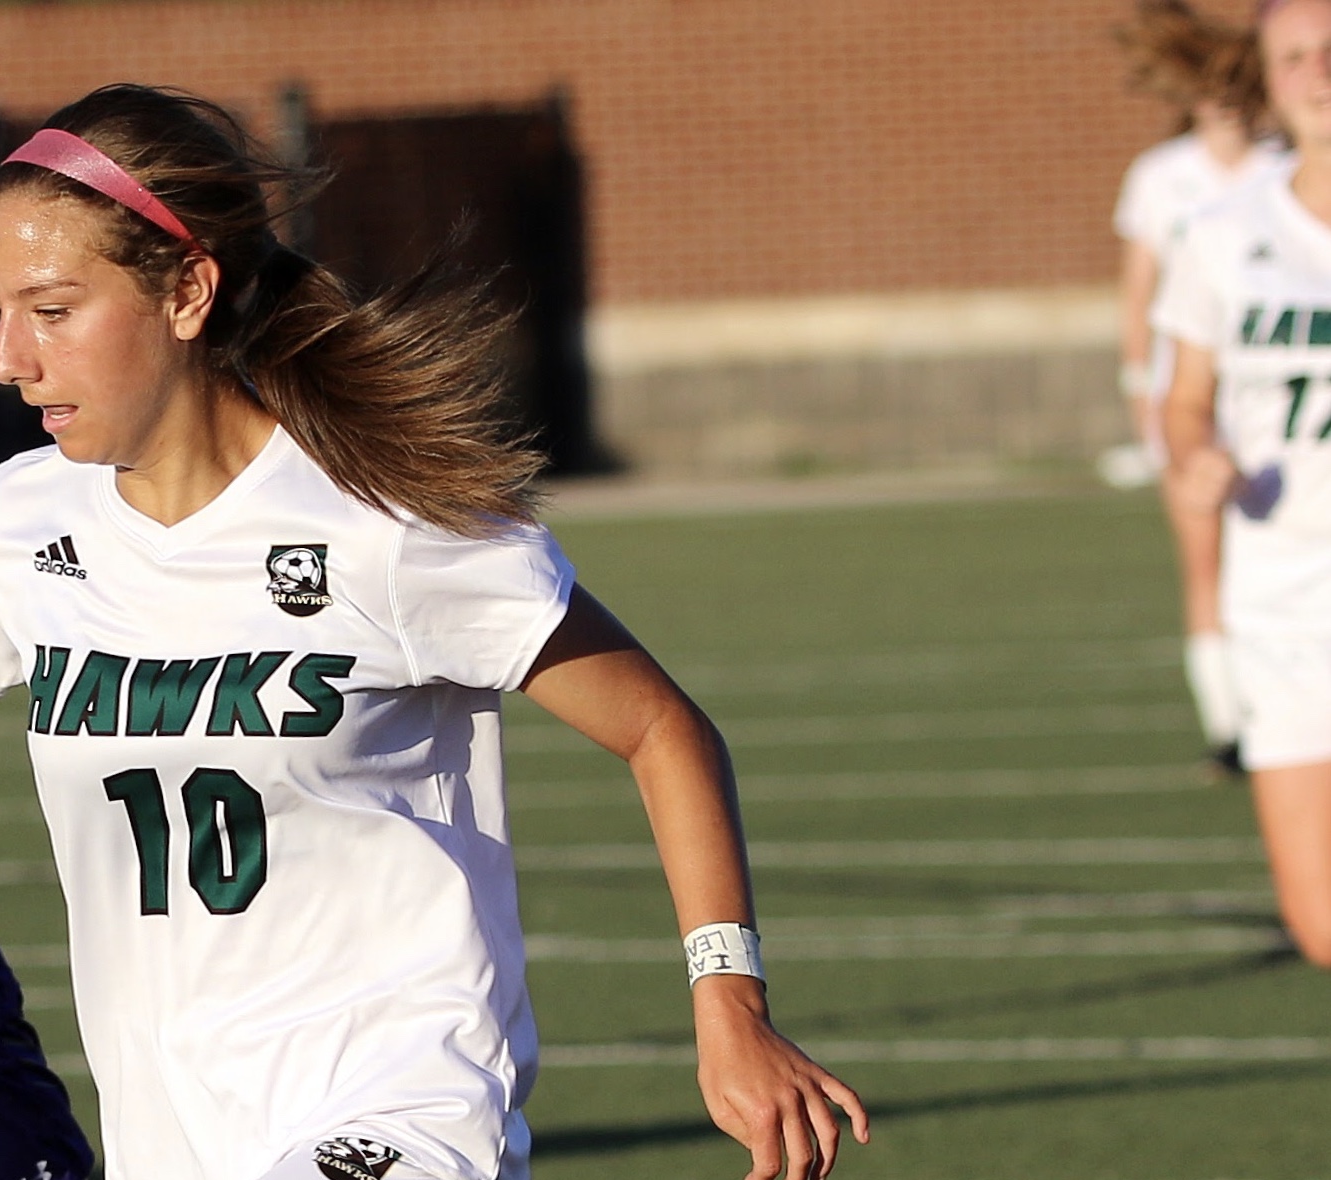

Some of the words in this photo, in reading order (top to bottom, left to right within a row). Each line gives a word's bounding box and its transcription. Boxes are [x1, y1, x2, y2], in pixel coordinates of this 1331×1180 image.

[34, 557, 88, 580] adidas
[273, 592, 334, 606] HAWKS
[28, 643, 357, 738] HAWKS
[102, 767, 268, 917] 10
